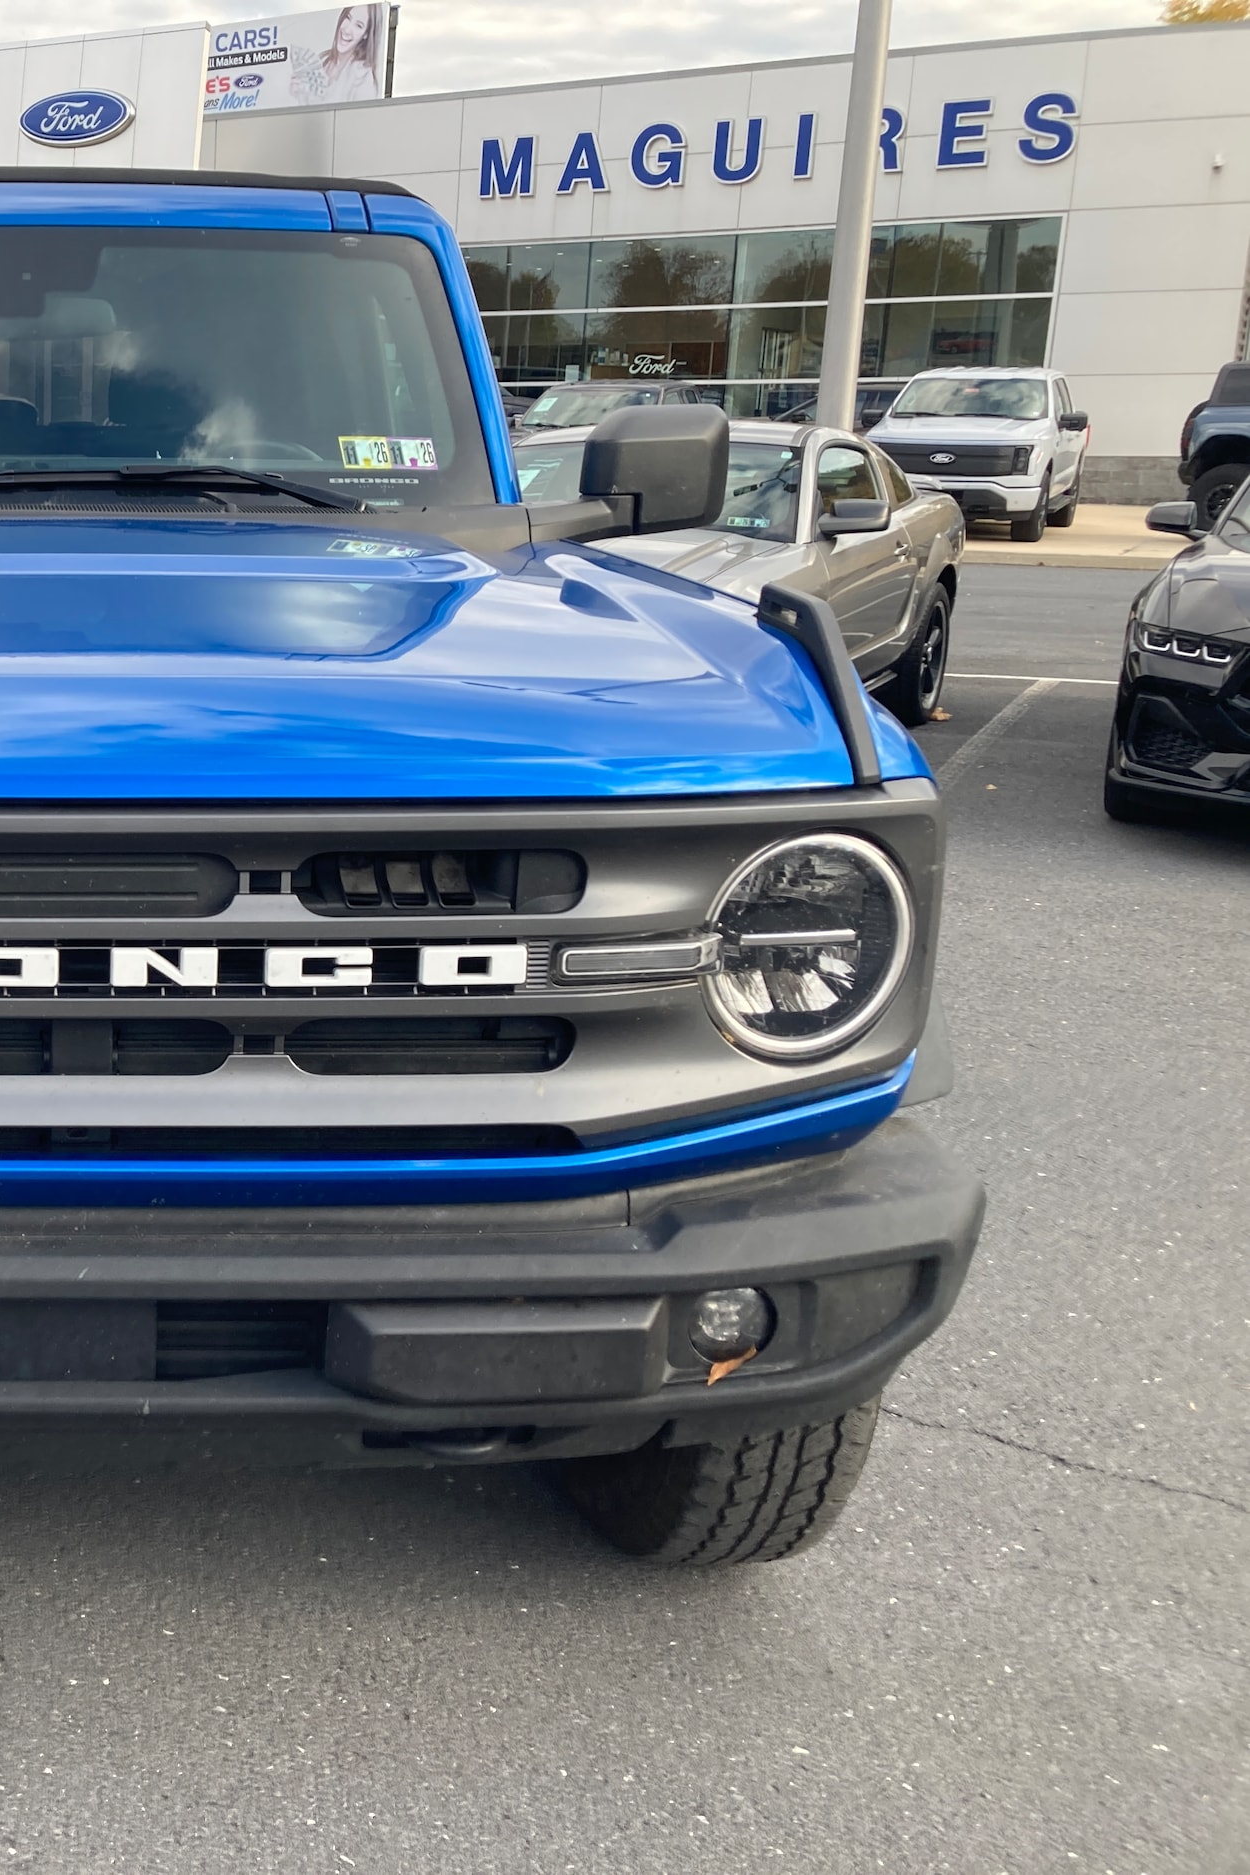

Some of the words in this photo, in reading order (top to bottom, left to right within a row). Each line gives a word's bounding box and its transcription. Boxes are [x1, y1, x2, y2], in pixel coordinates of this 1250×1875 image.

[215, 26, 278, 52] CARS!
[216, 55, 243, 67] Makes
[244, 54, 252, 63] &
[253, 50, 285, 62] Models
[205, 75, 230, 94] E'S
[238, 75, 259, 87] Ford
[219, 89, 260, 111] More!
[40, 100, 105, 133] Ford
[478, 92, 1080, 200] MAGUIRES
[629, 354, 677, 375] Ford
[374, 442, 388, 463] 26
[420, 442, 435, 464] 26
